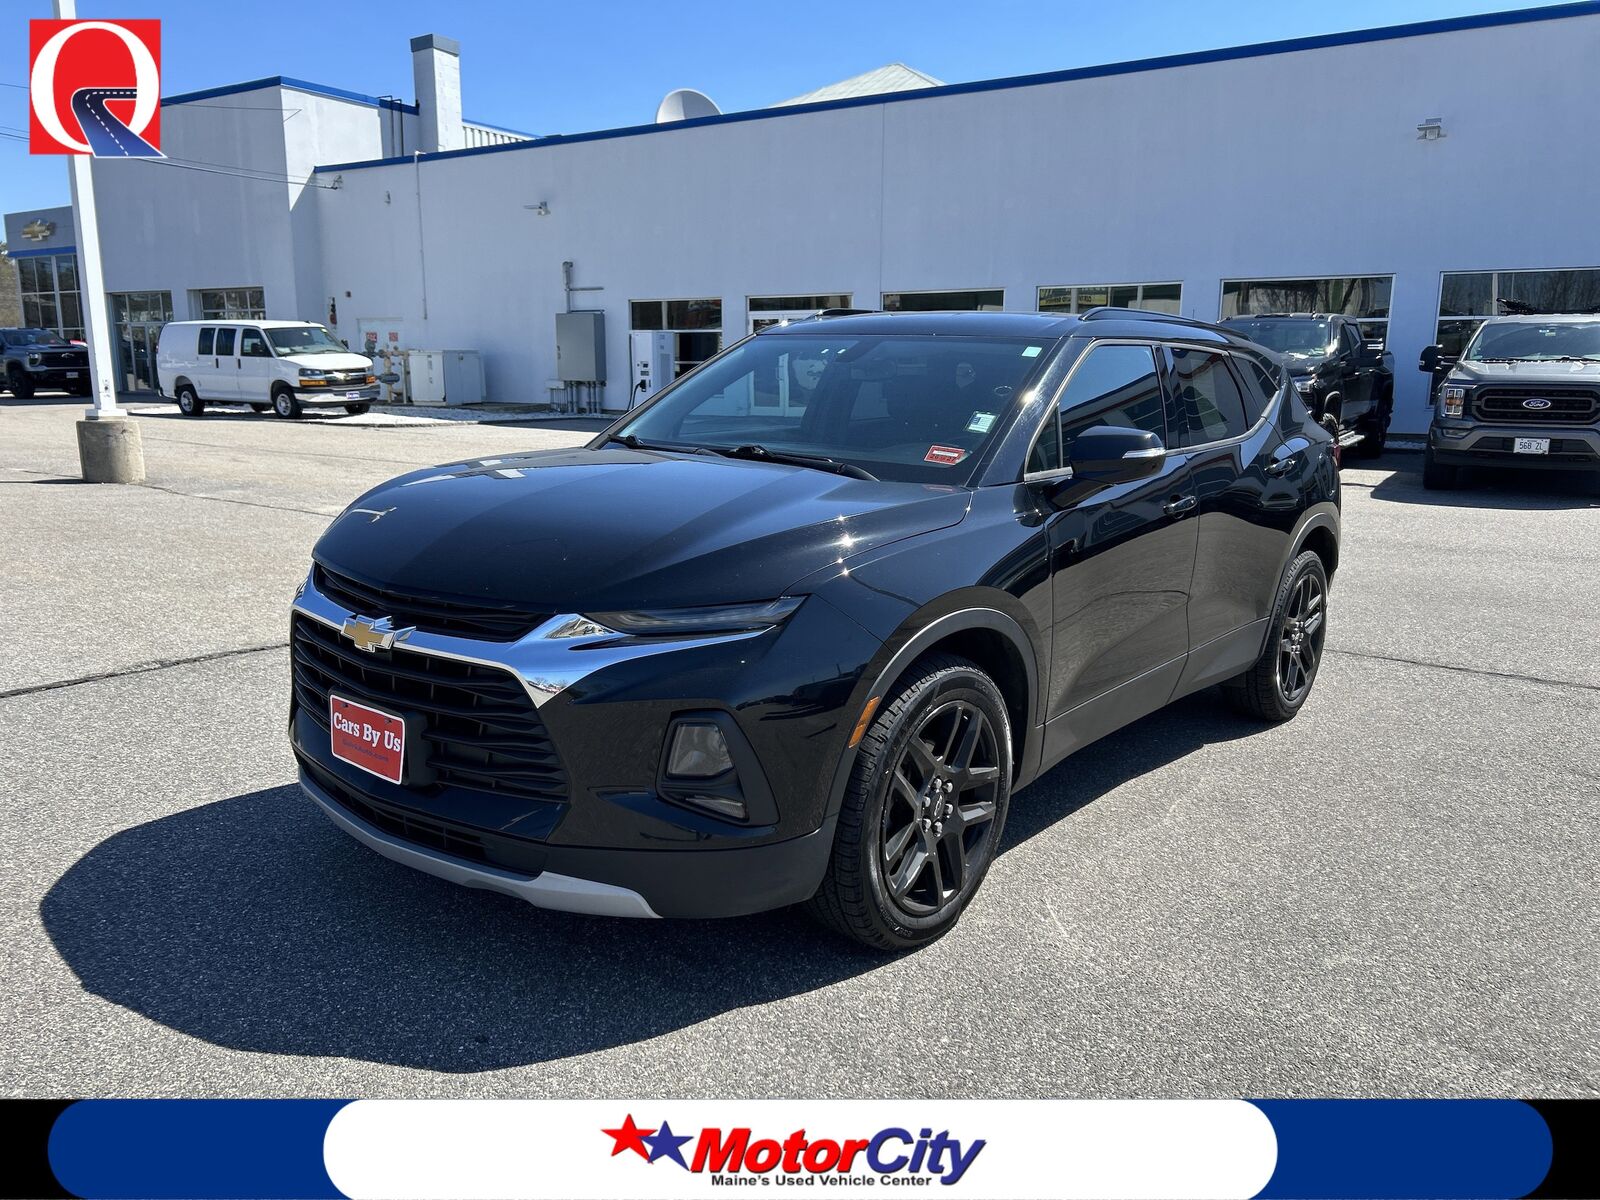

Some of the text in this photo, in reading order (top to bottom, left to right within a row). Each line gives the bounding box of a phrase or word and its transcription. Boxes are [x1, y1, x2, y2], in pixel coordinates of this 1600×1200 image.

[333, 712, 359, 737] Cars
[363, 724, 380, 747] By
[384, 731, 401, 752] Us
